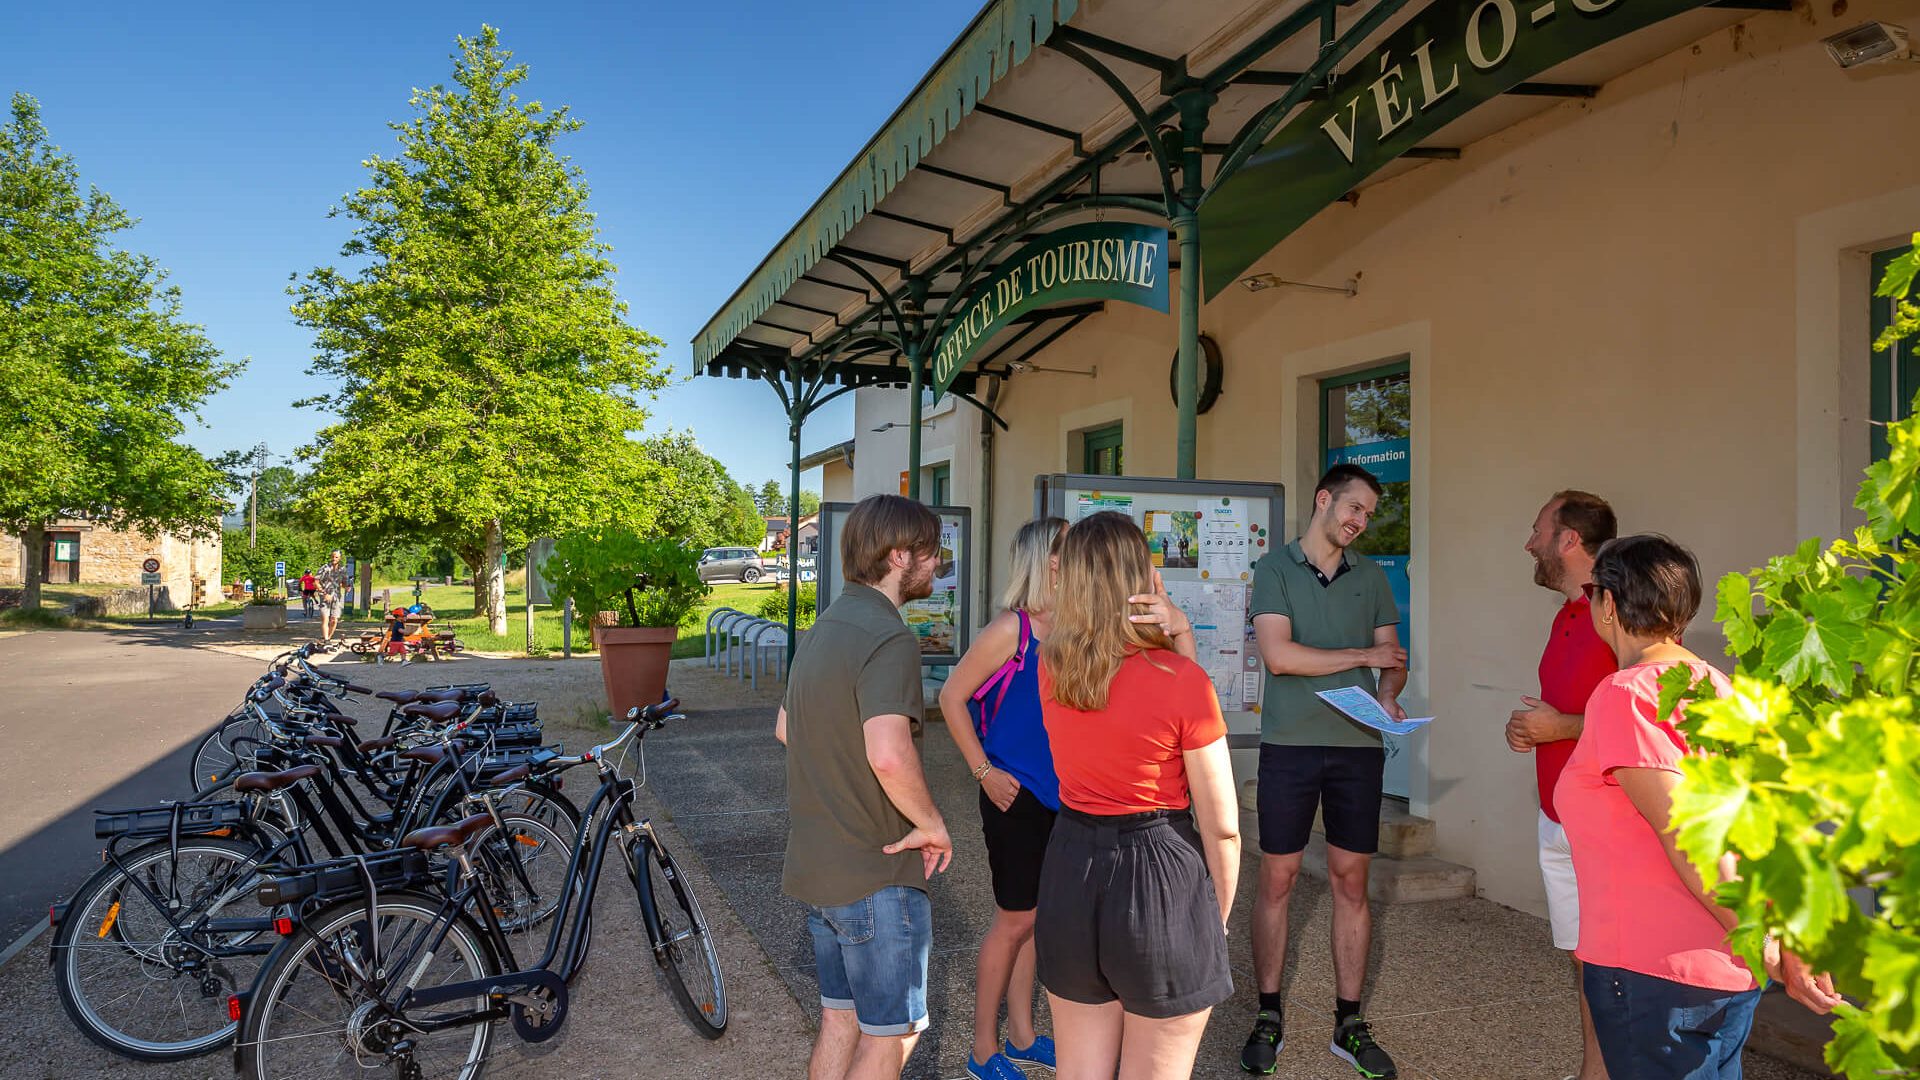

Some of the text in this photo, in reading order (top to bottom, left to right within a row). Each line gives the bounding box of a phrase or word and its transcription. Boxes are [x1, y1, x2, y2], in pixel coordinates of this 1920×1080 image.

[1320, 0, 1620, 164] VÉLO-
[936, 237, 1158, 384] OFFICE DE TOURISME
[1347, 450, 1405, 466] Information
